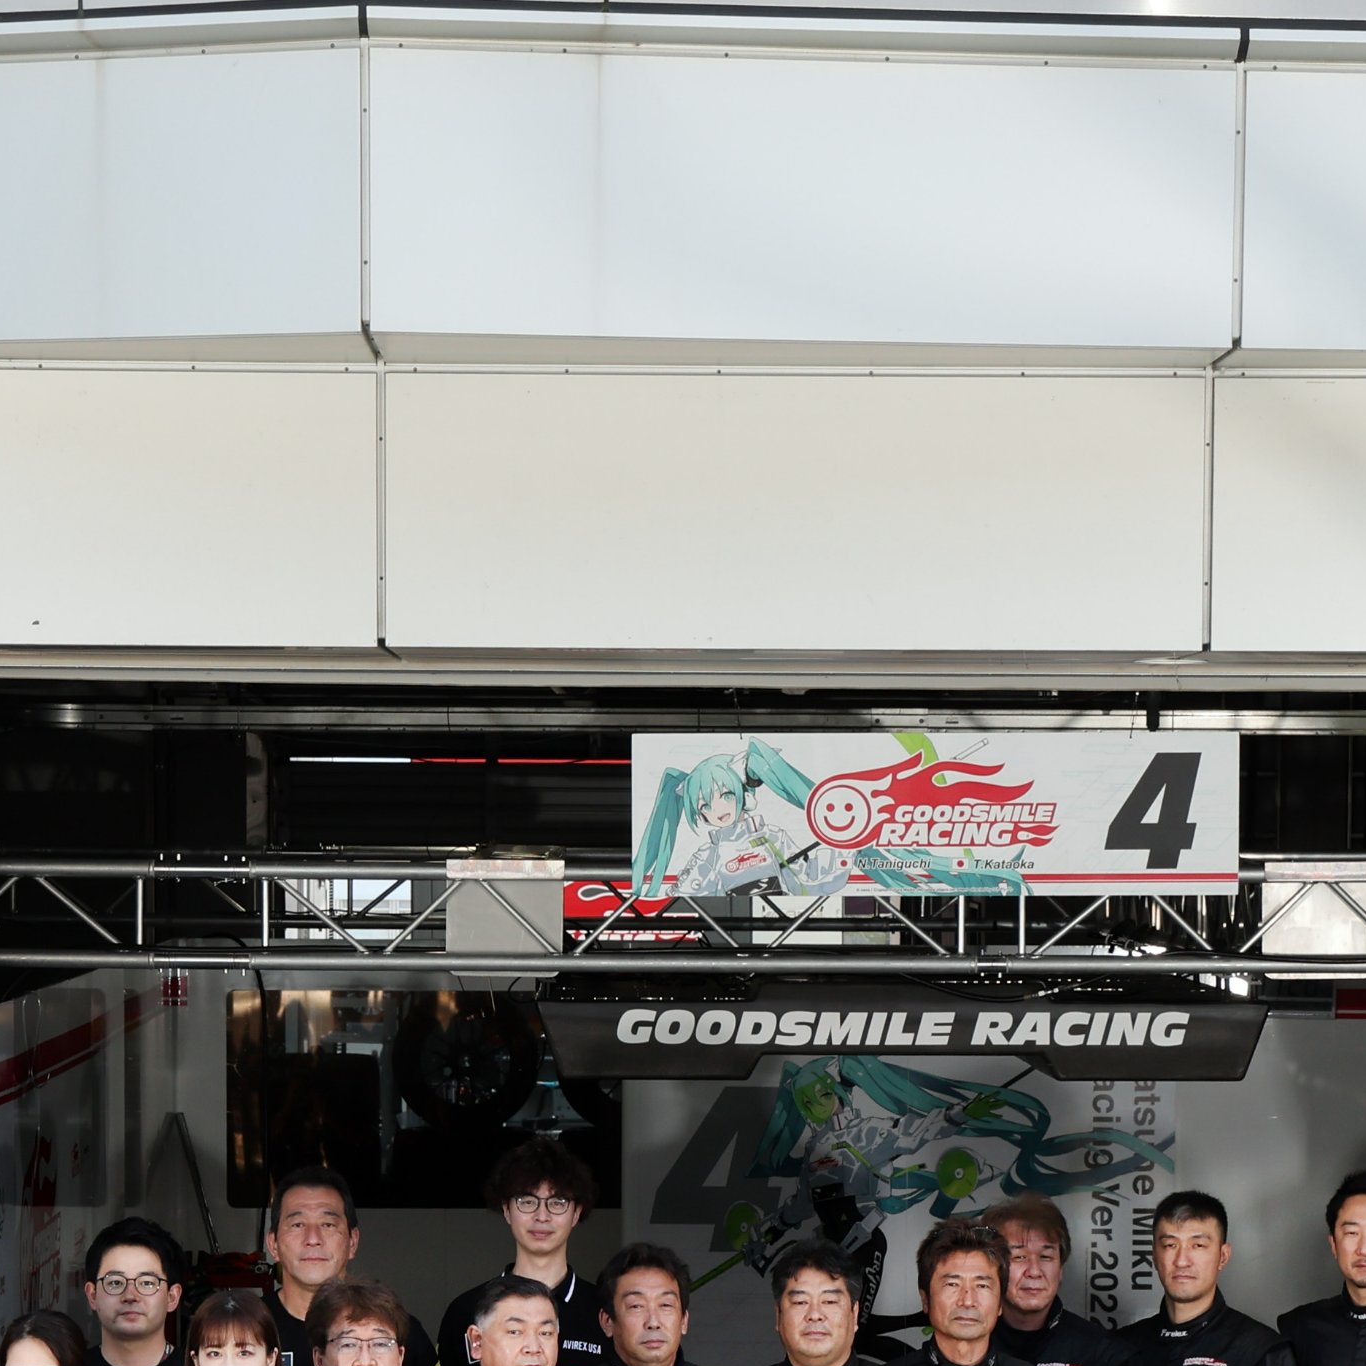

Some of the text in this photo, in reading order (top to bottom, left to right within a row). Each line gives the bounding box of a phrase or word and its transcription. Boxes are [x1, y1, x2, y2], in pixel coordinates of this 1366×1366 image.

[894, 803, 1055, 823] GOODSMILE
[1105, 752, 1203, 869] 4
[879, 823, 1015, 846] RACING
[857, 858, 931, 870] N.Taniguchi
[974, 859, 1035, 870] T.Kataoka
[616, 1010, 1190, 1047] GOODSMILE RACING
[562, 1340, 602, 1355] AVIREX USA
